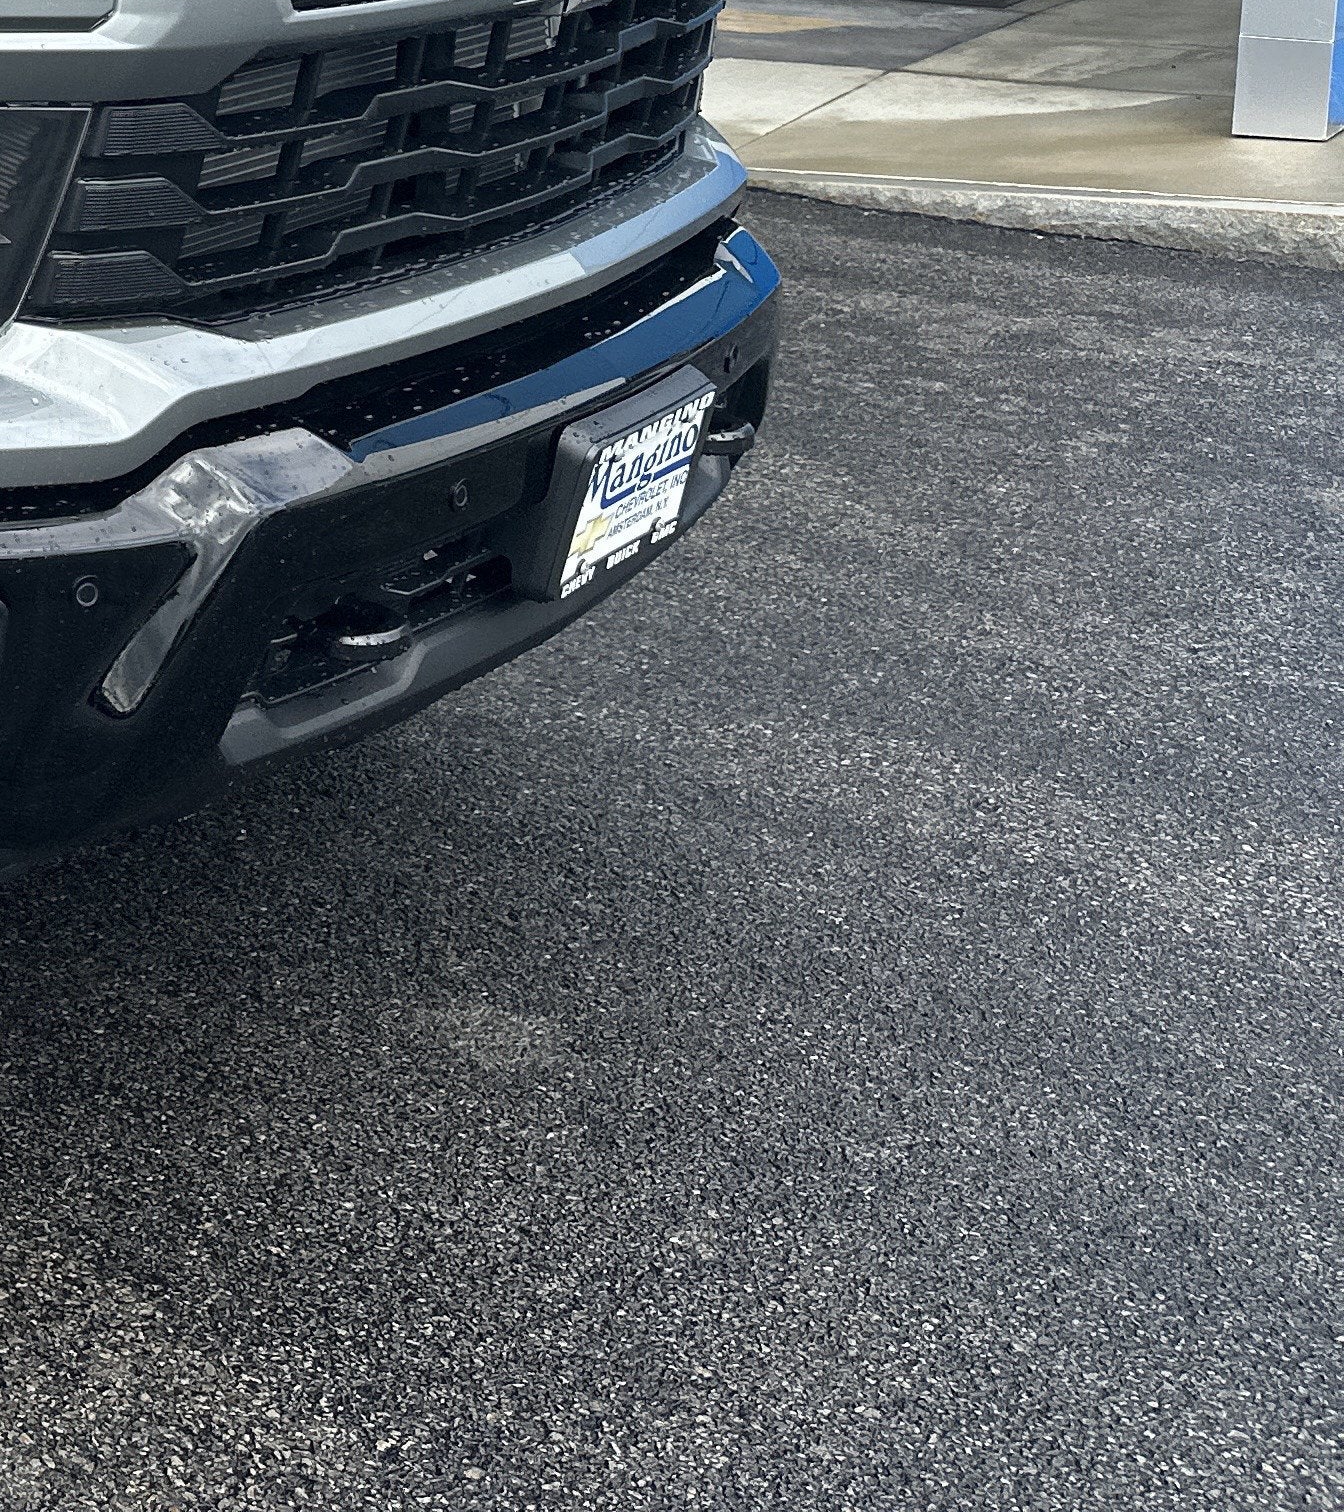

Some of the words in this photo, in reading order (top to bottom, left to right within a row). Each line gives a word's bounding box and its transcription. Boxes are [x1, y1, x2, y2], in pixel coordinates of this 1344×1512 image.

[588, 424, 699, 506] Mangino
[598, 391, 715, 465] MANGINO
[560, 566, 596, 599] CHEVY
[606, 539, 641, 570] BUICK
[650, 520, 678, 544] GMC
